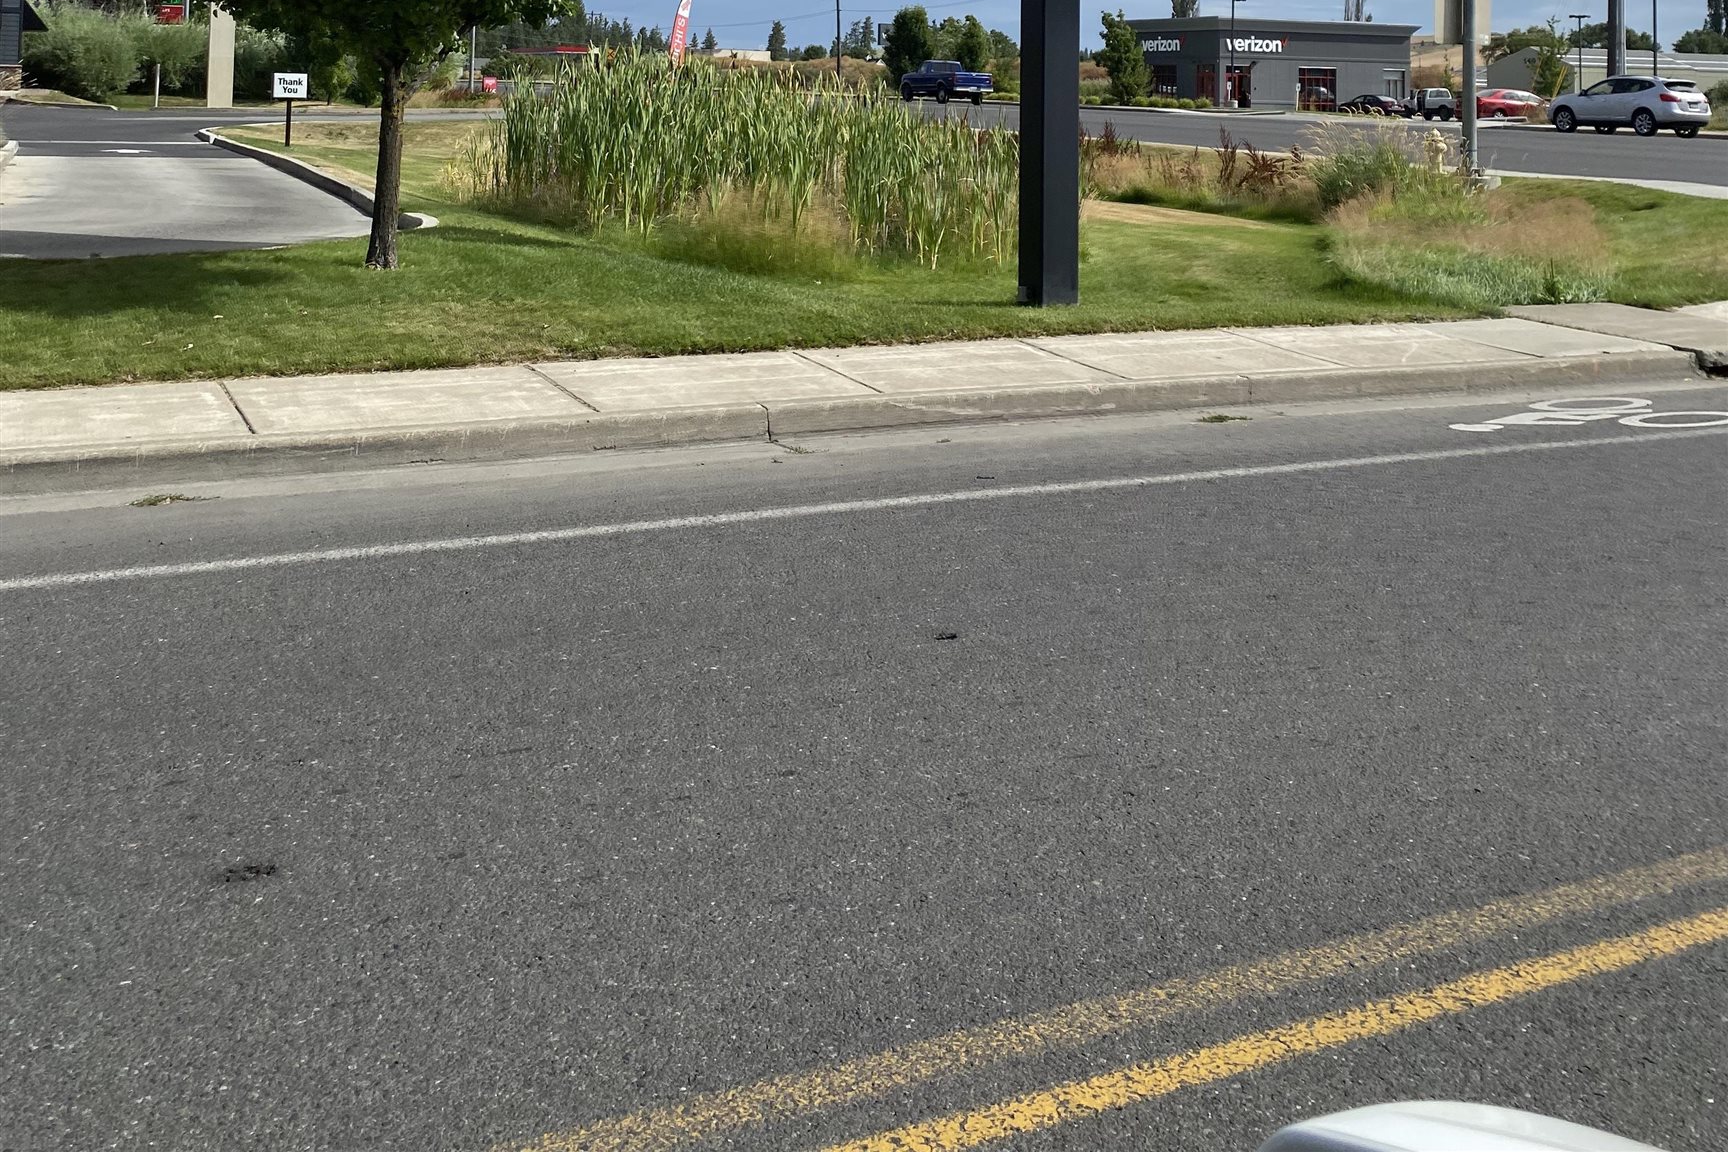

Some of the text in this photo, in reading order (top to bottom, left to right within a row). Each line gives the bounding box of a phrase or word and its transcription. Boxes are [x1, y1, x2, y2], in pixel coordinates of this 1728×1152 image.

[1142, 35, 1181, 52] verizon
[1226, 35, 1282, 53] verizon
[277, 77, 303, 85] Thank
